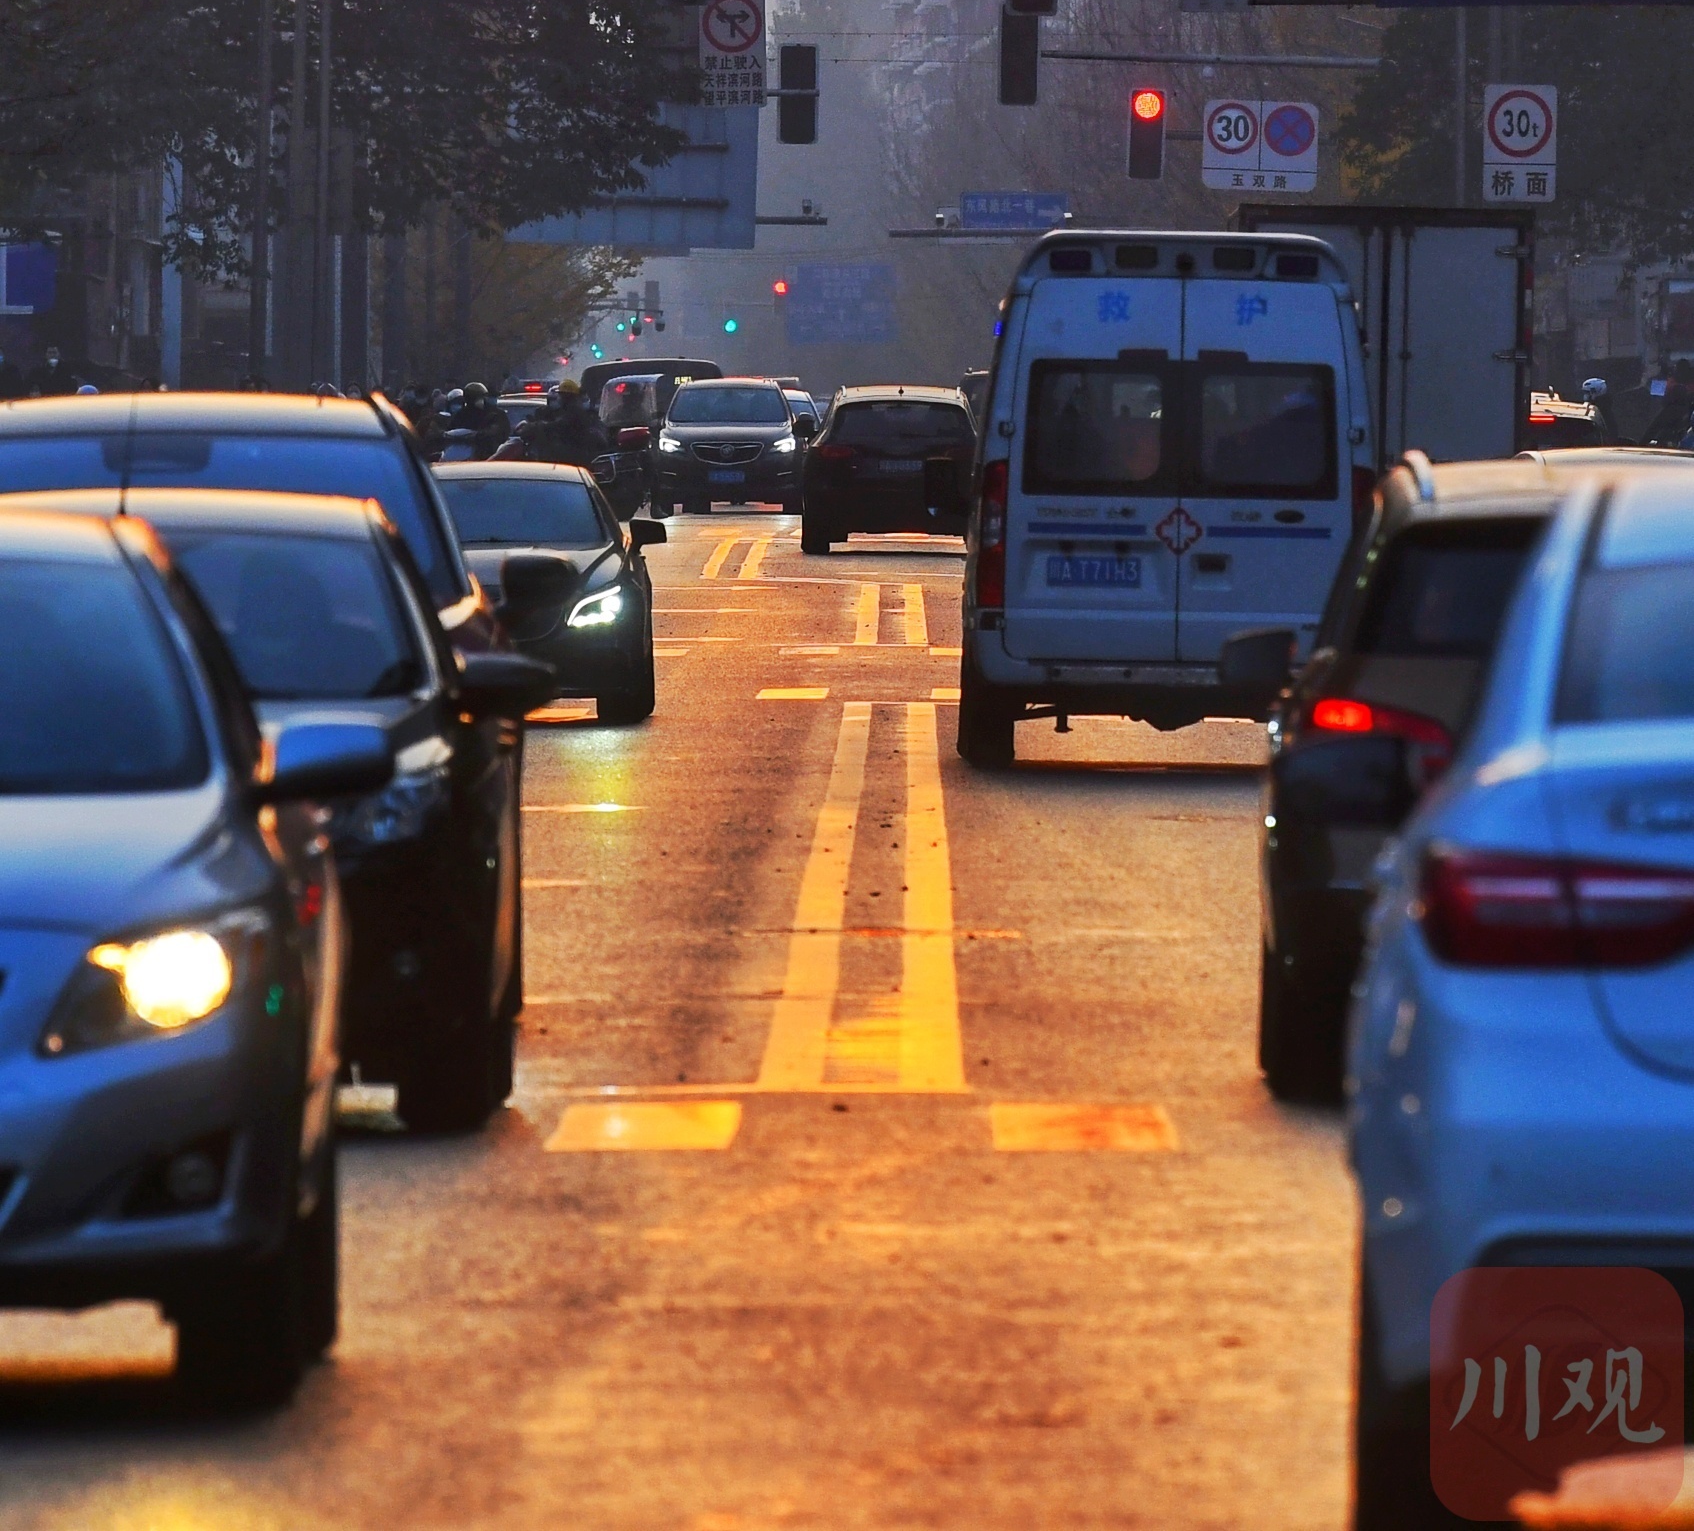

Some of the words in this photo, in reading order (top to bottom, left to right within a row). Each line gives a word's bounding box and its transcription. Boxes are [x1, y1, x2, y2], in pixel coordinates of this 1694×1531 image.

[704, 54, 762, 71] 禁止驶入
[704, 72, 763, 88] 天祥滨河路
[704, 89, 764, 106] 望平滨河路
[1216, 114, 1250, 142] 30
[1501, 109, 1540, 138] 30t
[1231, 173, 1288, 189] 玉双路
[1491, 170, 1549, 197] 桥面
